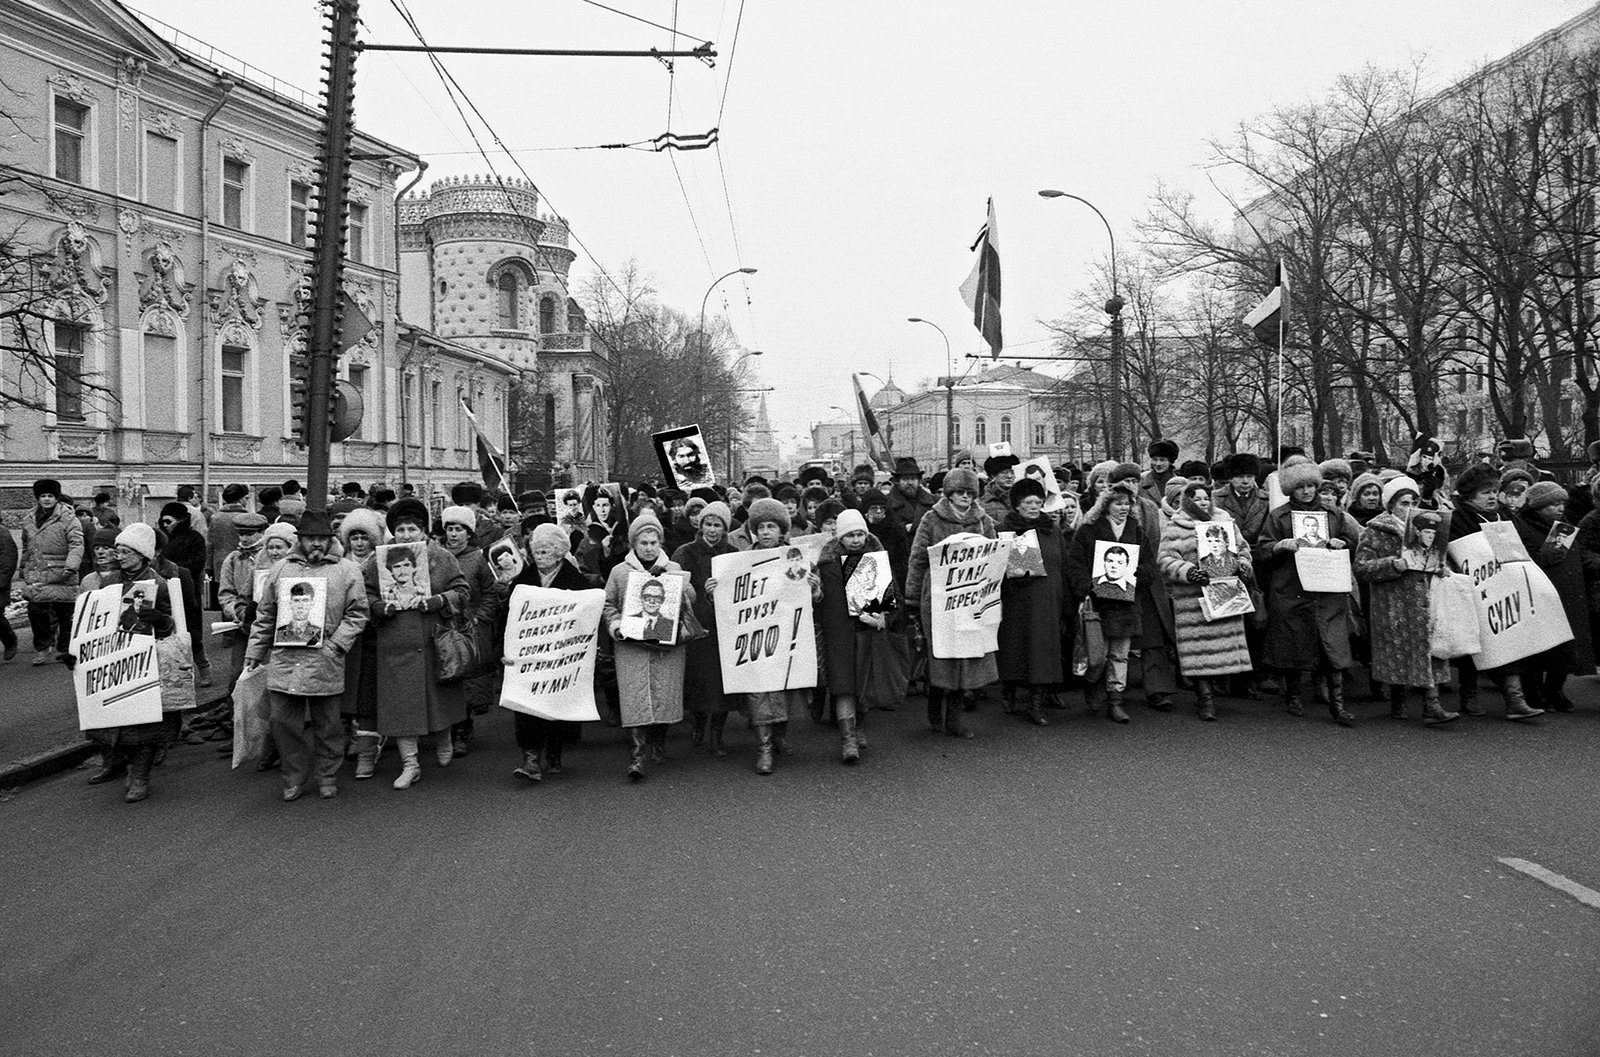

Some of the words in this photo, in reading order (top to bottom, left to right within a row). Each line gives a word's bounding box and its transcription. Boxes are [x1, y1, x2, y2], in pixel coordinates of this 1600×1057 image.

[733, 572, 769, 604] НЕТ
[518, 601, 577, 622] РОДИТЕЛИ
[738, 599, 778, 625] ГРУЗУ
[519, 618, 577, 640] СПАСАЙТЕ
[519, 643, 553, 657] СВОИХ
[554, 628, 596, 651] СЫНОВЕЙ
[80, 631, 133, 665] ВОЕННОМУ
[520, 663, 533, 674] ОТ
[534, 645, 588, 672] АРМЕЙСКОЙ
[86, 645, 153, 696] ПЕРЕВОРОТУ!
[531, 666, 580, 696] ЧУМЫ!
